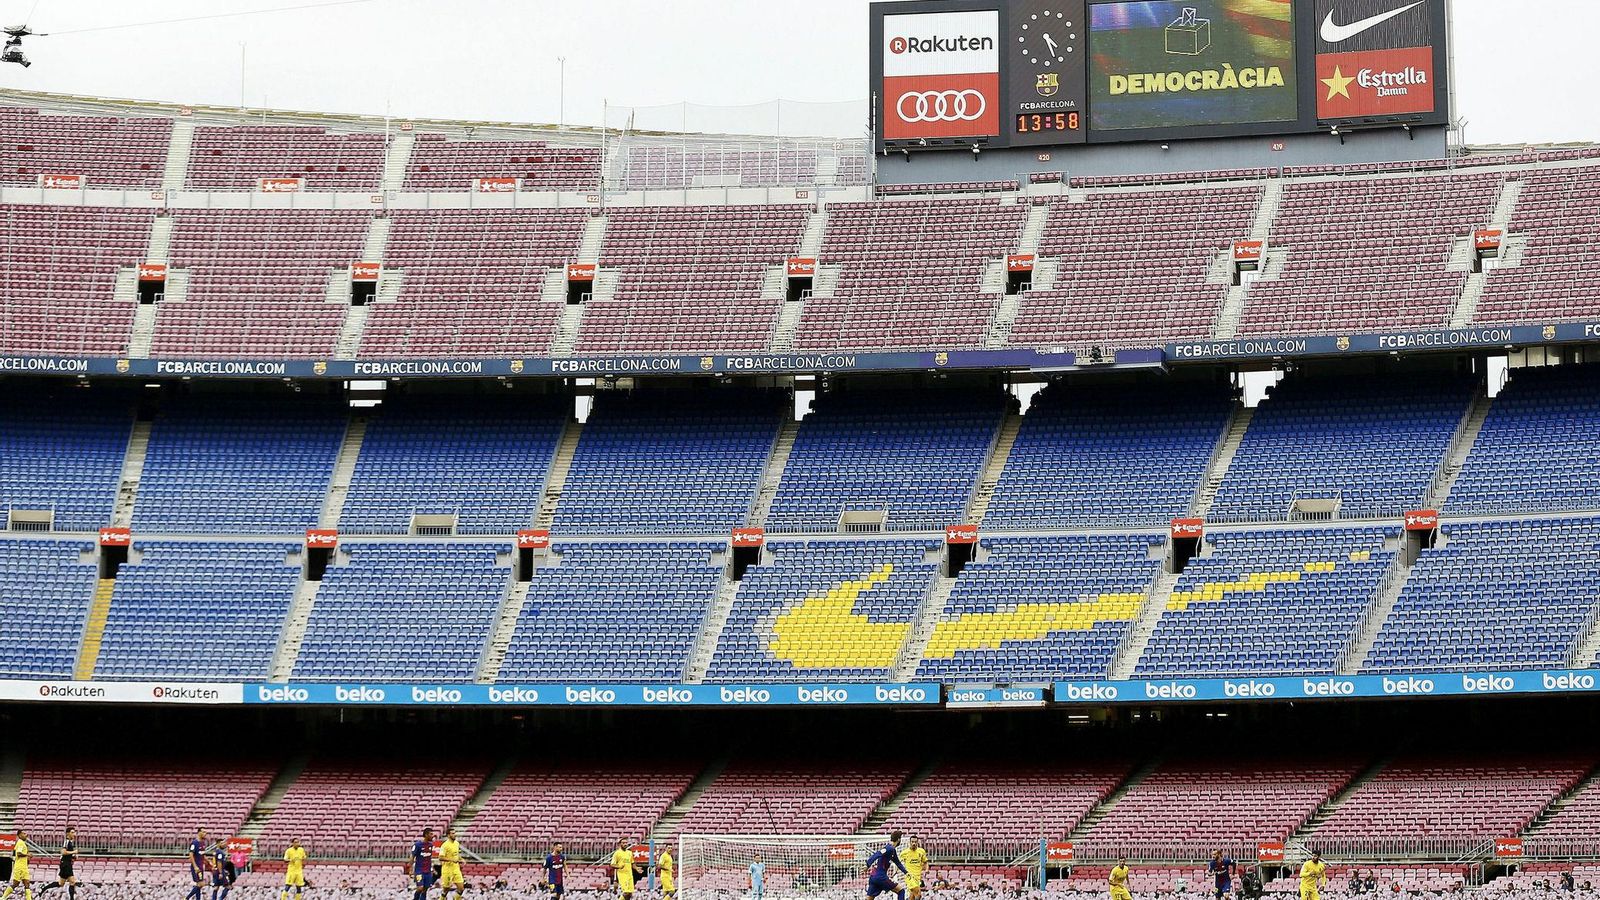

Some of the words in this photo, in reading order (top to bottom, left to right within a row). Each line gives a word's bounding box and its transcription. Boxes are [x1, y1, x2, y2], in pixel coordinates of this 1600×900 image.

[908, 35, 993, 53] Rakuten
[1109, 62, 1285, 95] DEMOCRÀCIA
[1357, 66, 1427, 88] Estrella
[1377, 87, 1408, 97] Damm
[1020, 101, 1075, 110] FCBARCELONA
[1018, 112, 1078, 132] 13:58
[1380, 330, 1511, 347] FCBARCELONA.COM
[1176, 340, 1306, 357] FCBARCELONA.COM
[158, 361, 286, 374] FCBARCELONA.COM
[354, 363, 482, 374] FCBARCELONA.COM
[552, 359, 680, 372] FCBARCELONA.COM
[727, 356, 855, 369] FCBARCELONA.COM
[51, 686, 105, 697] Rakuten
[1068, 683, 1118, 699] beko
[1146, 681, 1196, 698] beko
[1224, 680, 1275, 696] beko
[1303, 678, 1354, 695] beko
[1383, 676, 1434, 694] beko
[1463, 674, 1514, 692] beko
[1543, 672, 1595, 690] beko
[165, 687, 219, 699] Rakuten
[259, 686, 309, 702] beko
[336, 686, 385, 702] beko
[412, 686, 462, 702] beko
[489, 686, 539, 702] beko
[566, 687, 616, 703] beko
[643, 687, 692, 703] beko
[721, 687, 770, 703] beko
[798, 686, 848, 703] beko
[875, 686, 926, 703] beko
[953, 690, 985, 702] beko
[1003, 688, 1034, 700] beko
